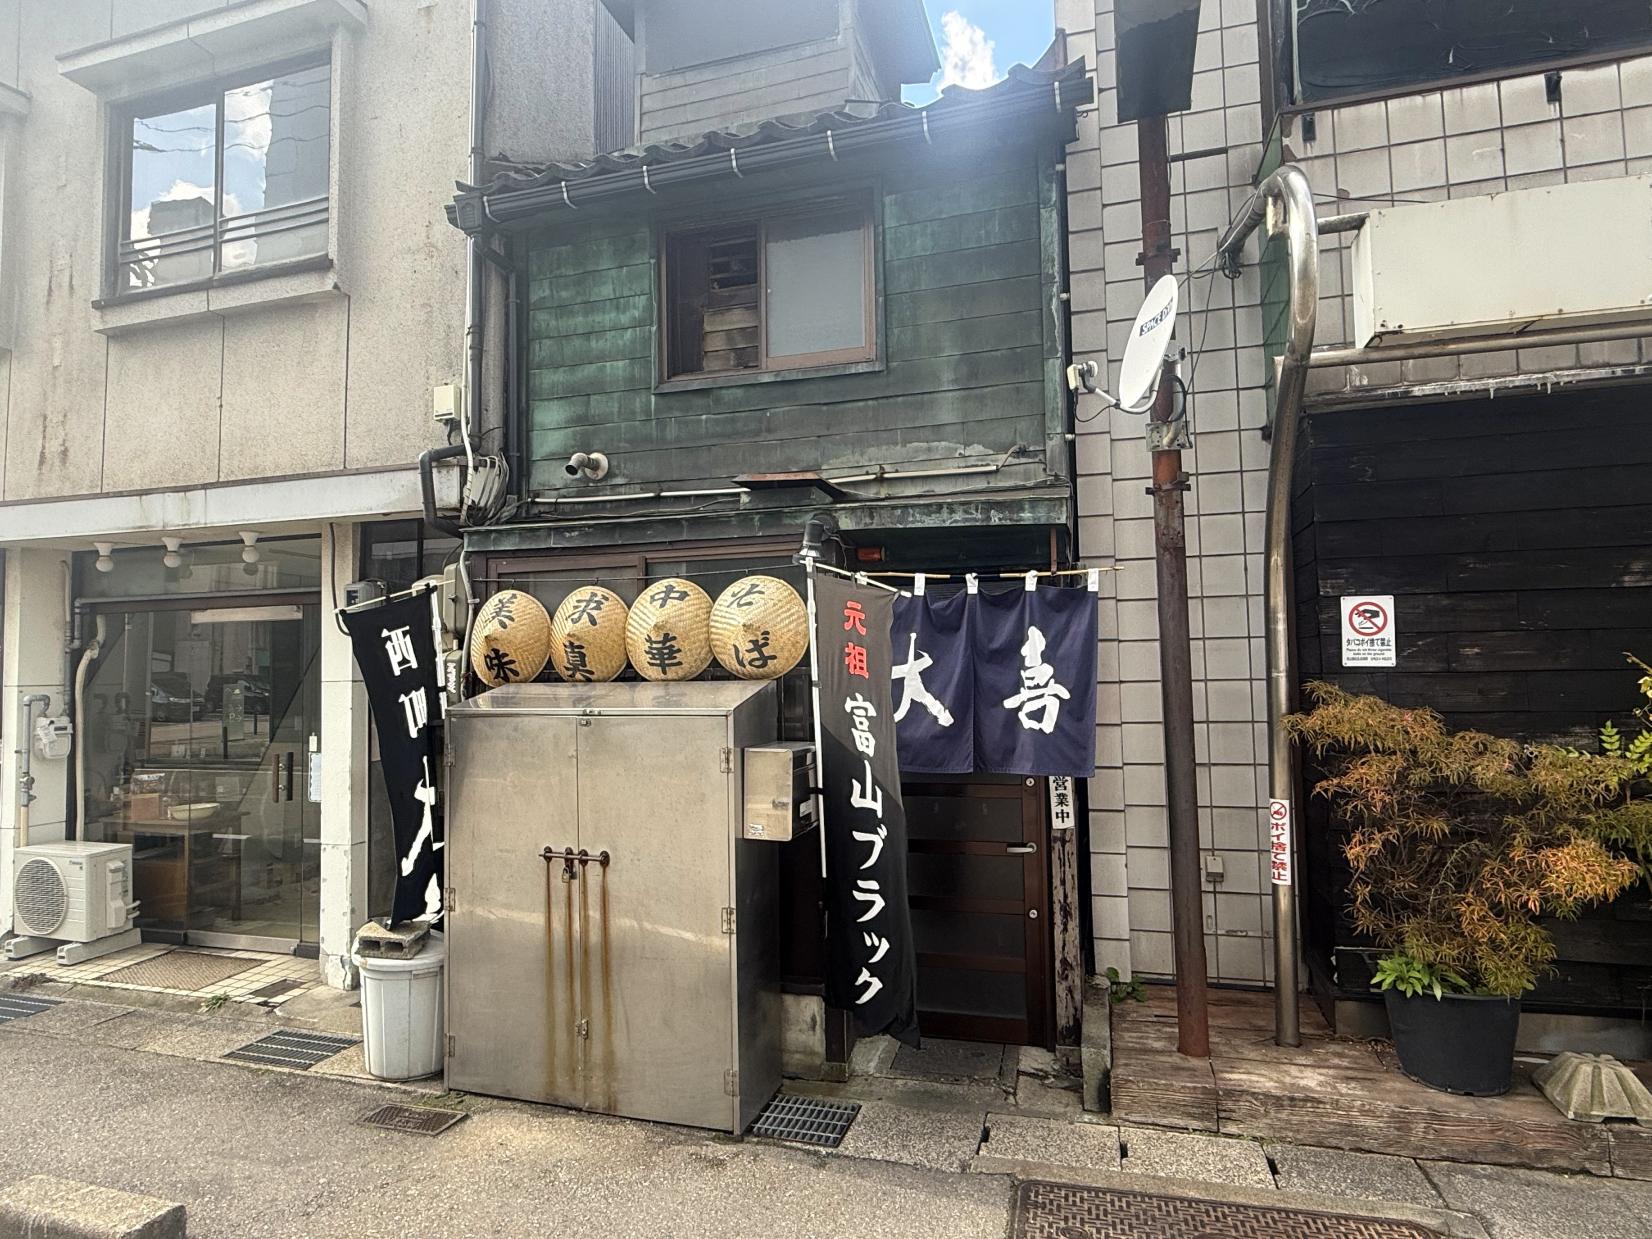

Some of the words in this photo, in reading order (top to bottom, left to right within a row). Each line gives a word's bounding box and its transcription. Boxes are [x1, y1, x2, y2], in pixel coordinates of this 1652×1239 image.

[484, 593, 521, 683] 美味
[645, 584, 690, 675] 中華
[727, 583, 777, 669] そば
[843, 599, 870, 680] 元祖
[891, 625, 1072, 734] 大喜
[1052, 776, 1070, 823] 営業中
[844, 692, 892, 1004] 富山ブラック
